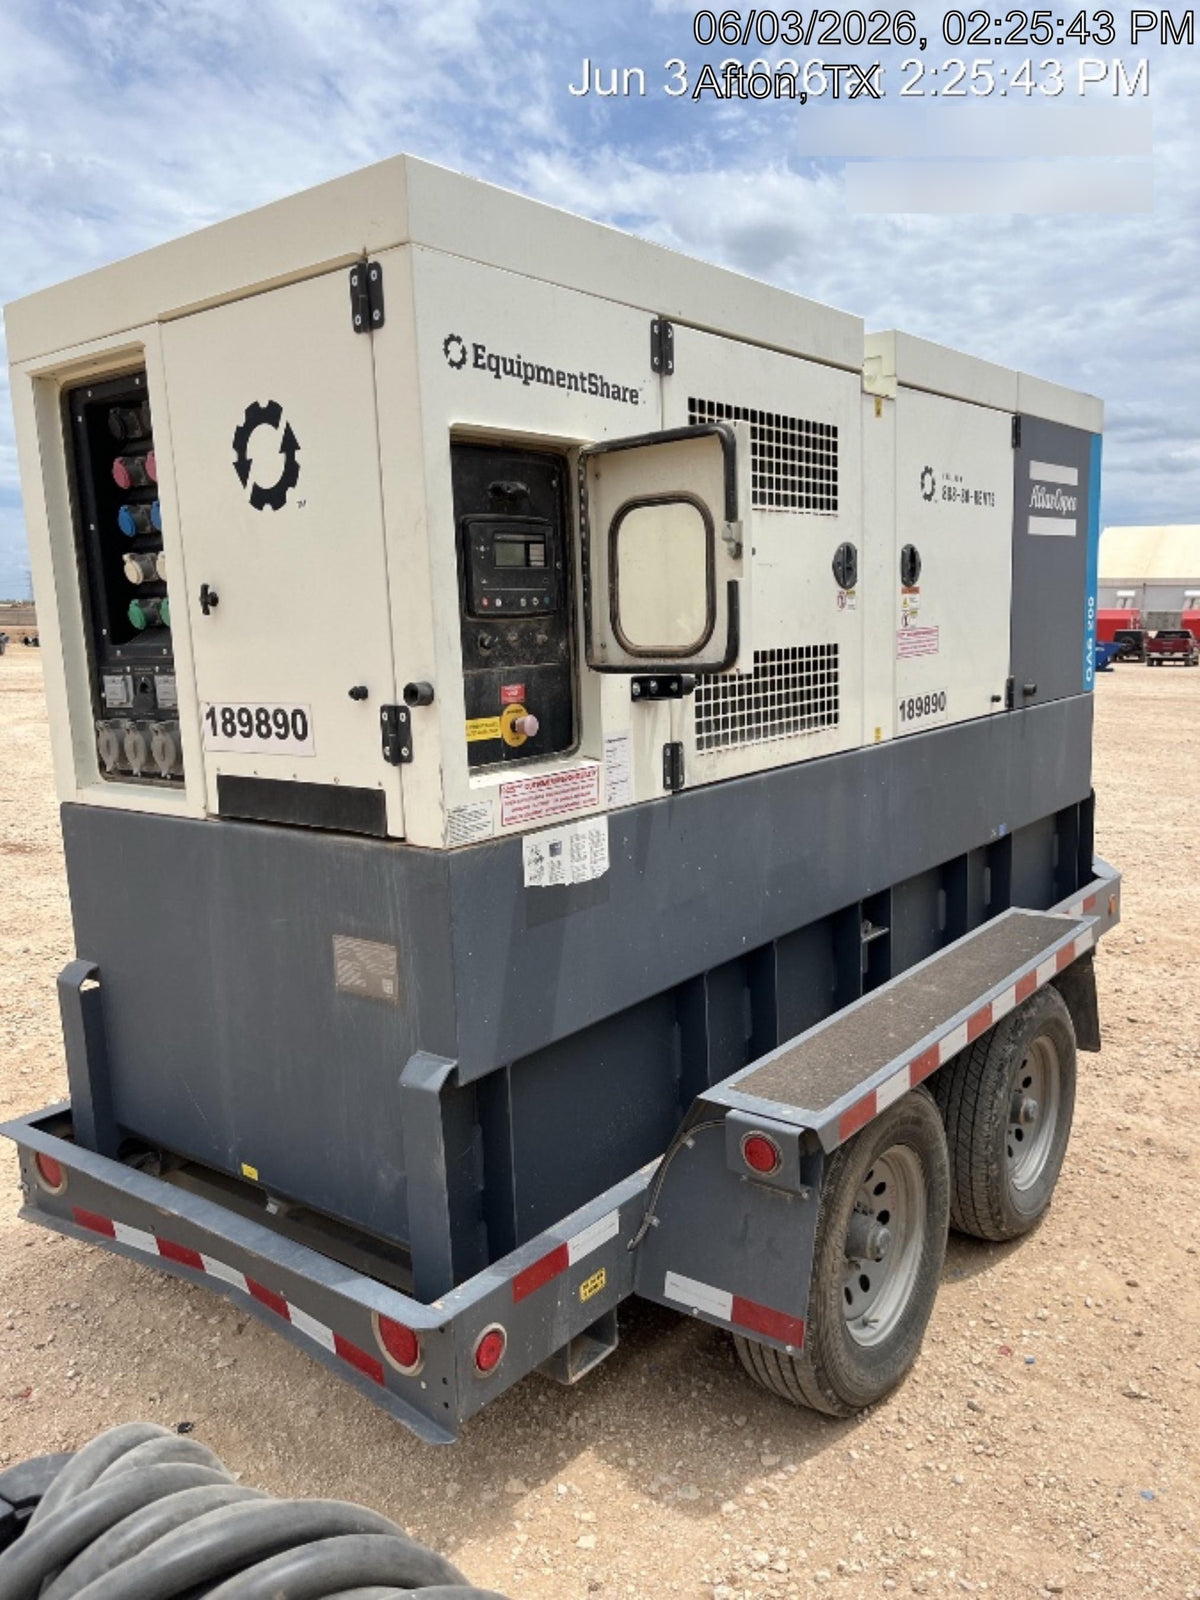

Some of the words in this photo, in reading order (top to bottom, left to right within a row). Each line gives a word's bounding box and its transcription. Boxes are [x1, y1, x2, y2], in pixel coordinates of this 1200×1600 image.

[471, 342, 640, 406] EquipmentShare
[205, 705, 309, 742] 189890
[899, 690, 948, 723] 189890
